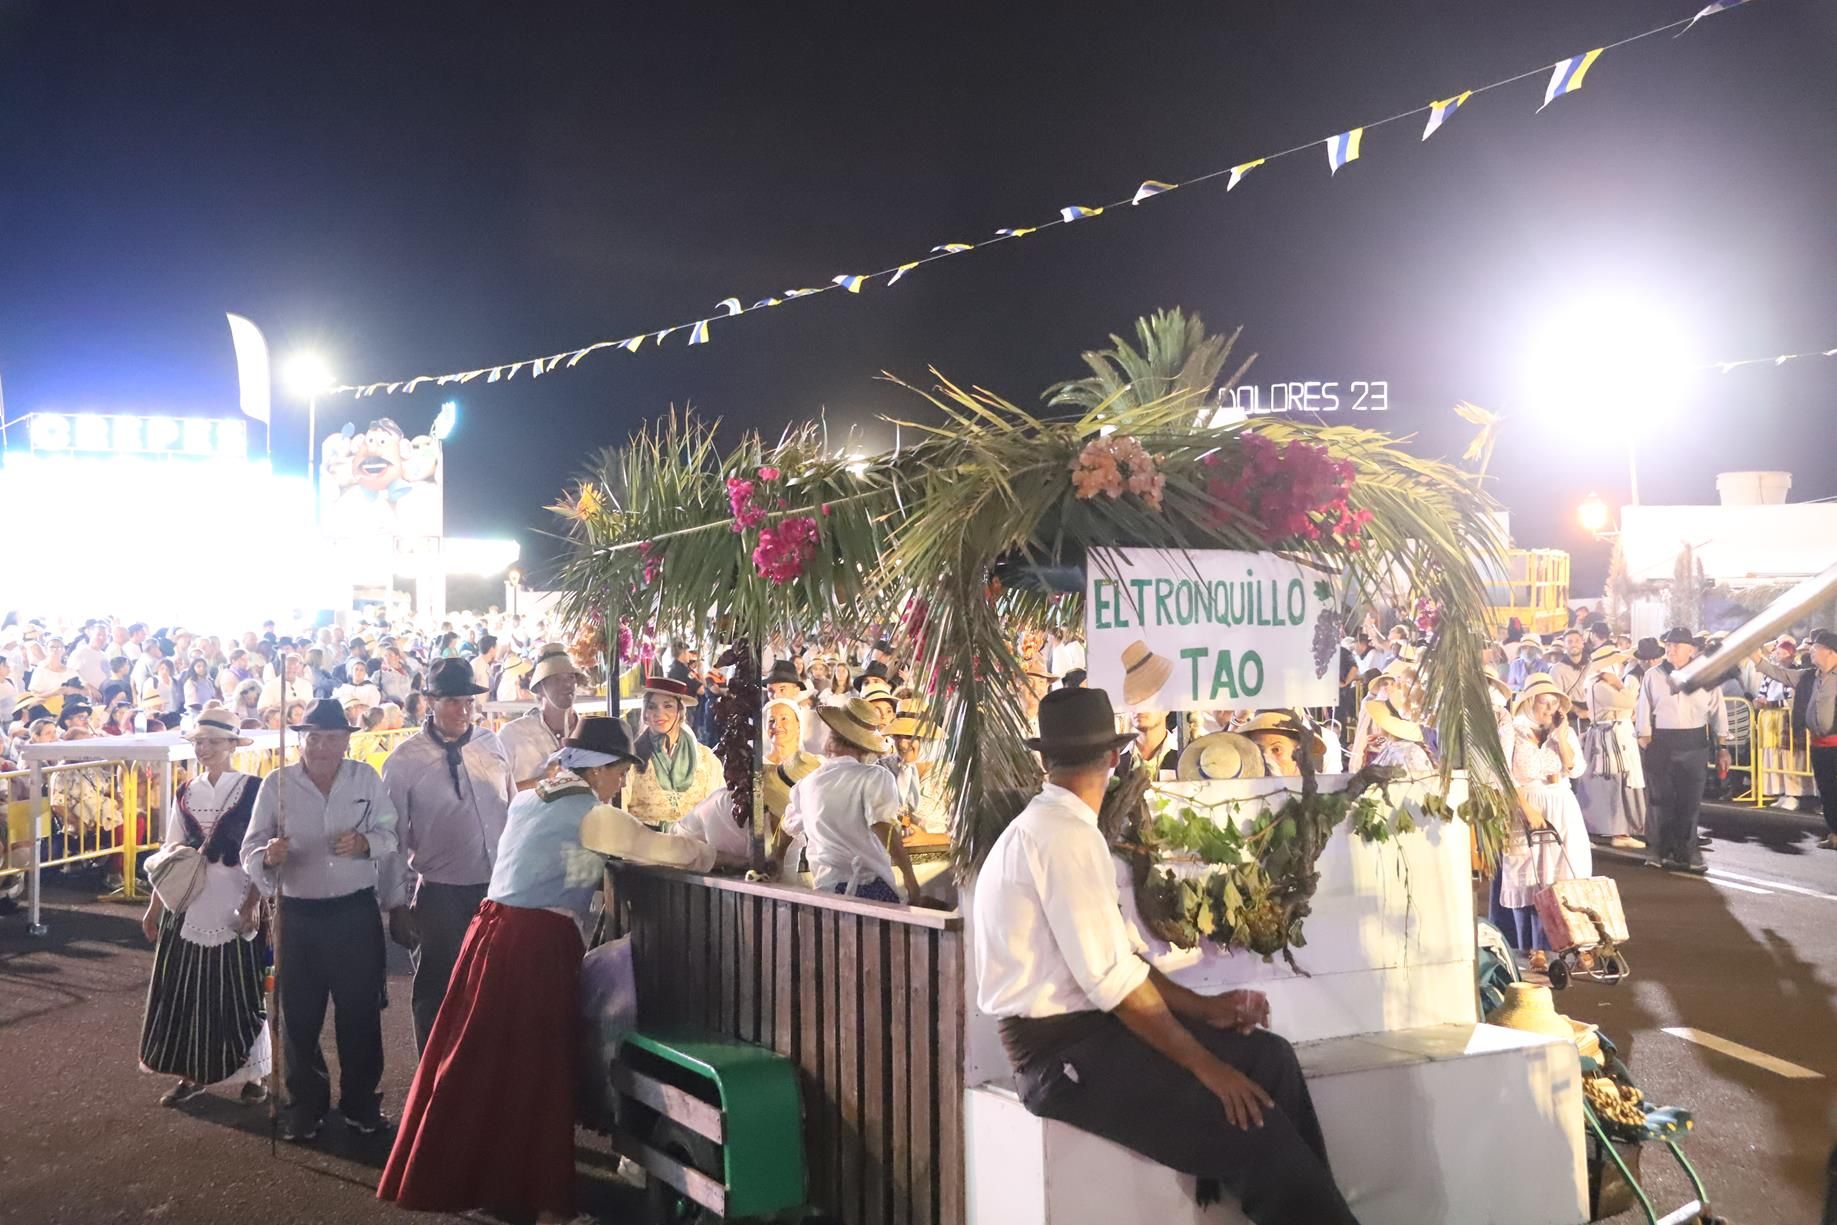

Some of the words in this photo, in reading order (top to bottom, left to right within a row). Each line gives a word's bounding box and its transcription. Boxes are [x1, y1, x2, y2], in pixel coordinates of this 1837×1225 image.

[1218, 381, 1340, 415] DOLORES
[1350, 381, 1388, 411] 23
[1180, 647, 1265, 701] TAO
